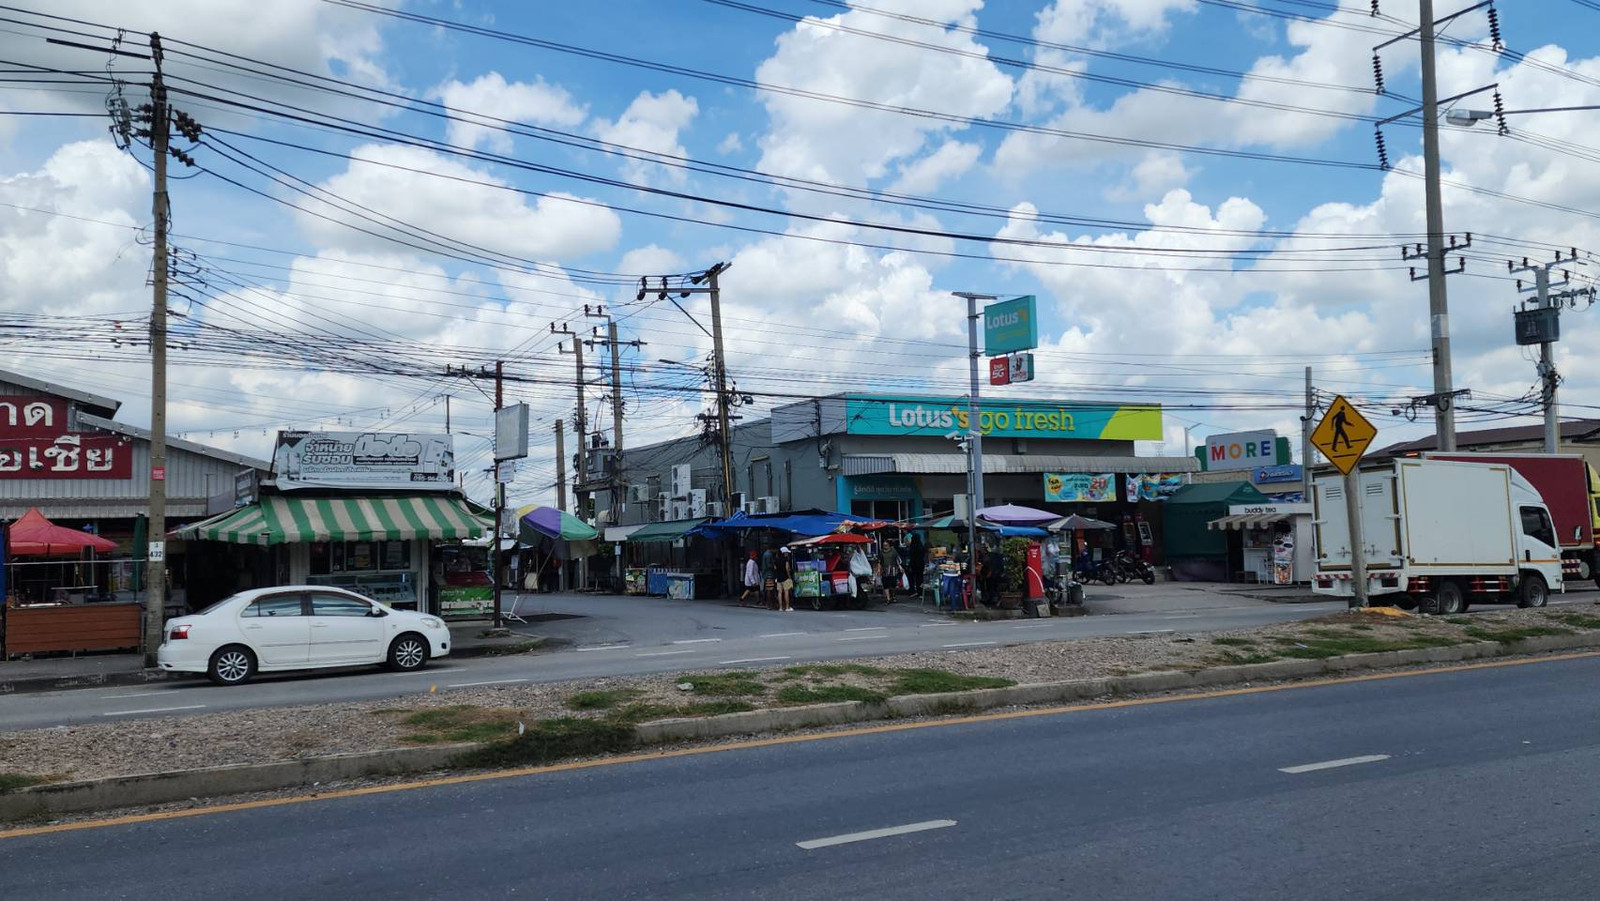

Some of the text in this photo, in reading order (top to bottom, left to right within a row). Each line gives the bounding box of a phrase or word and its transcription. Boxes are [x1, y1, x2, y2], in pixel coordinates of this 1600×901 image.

[986, 309, 1028, 330] Lotus
[889, 404, 1076, 435] Lotus's go fresh
[1211, 440, 1271, 462] MORE
[1244, 506, 1264, 514] buddy
